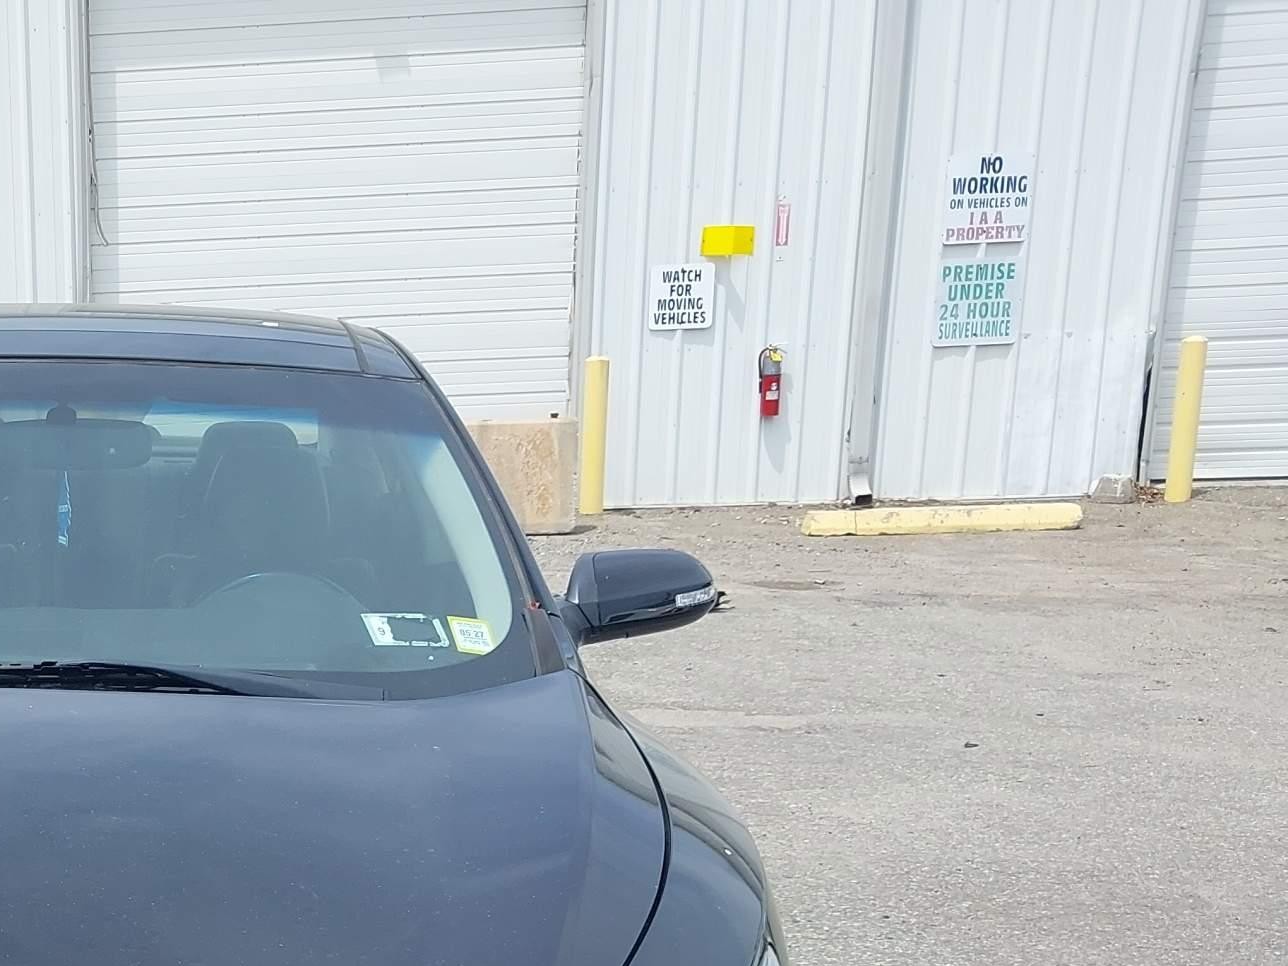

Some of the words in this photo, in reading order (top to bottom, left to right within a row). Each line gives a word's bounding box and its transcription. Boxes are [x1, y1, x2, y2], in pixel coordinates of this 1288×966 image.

[980, 156, 1003, 174] NO
[952, 175, 1028, 195] WORKING
[949, 199, 964, 210] ON
[967, 197, 1011, 209] VEHICLES
[1014, 196, 1028, 208] ON
[945, 225, 1025, 242] PROPERTY
[662, 269, 702, 283] WATCH
[942, 263, 1016, 283] PREMISE
[669, 284, 692, 297] FOR
[948, 282, 1005, 302] UNDER
[657, 297, 704, 311] MOVING
[939, 303, 960, 321] 24
[966, 301, 1012, 319] HOUR
[654, 311, 706, 325] VEHICLES
[938, 320, 1011, 340] SURVEILLANCE
